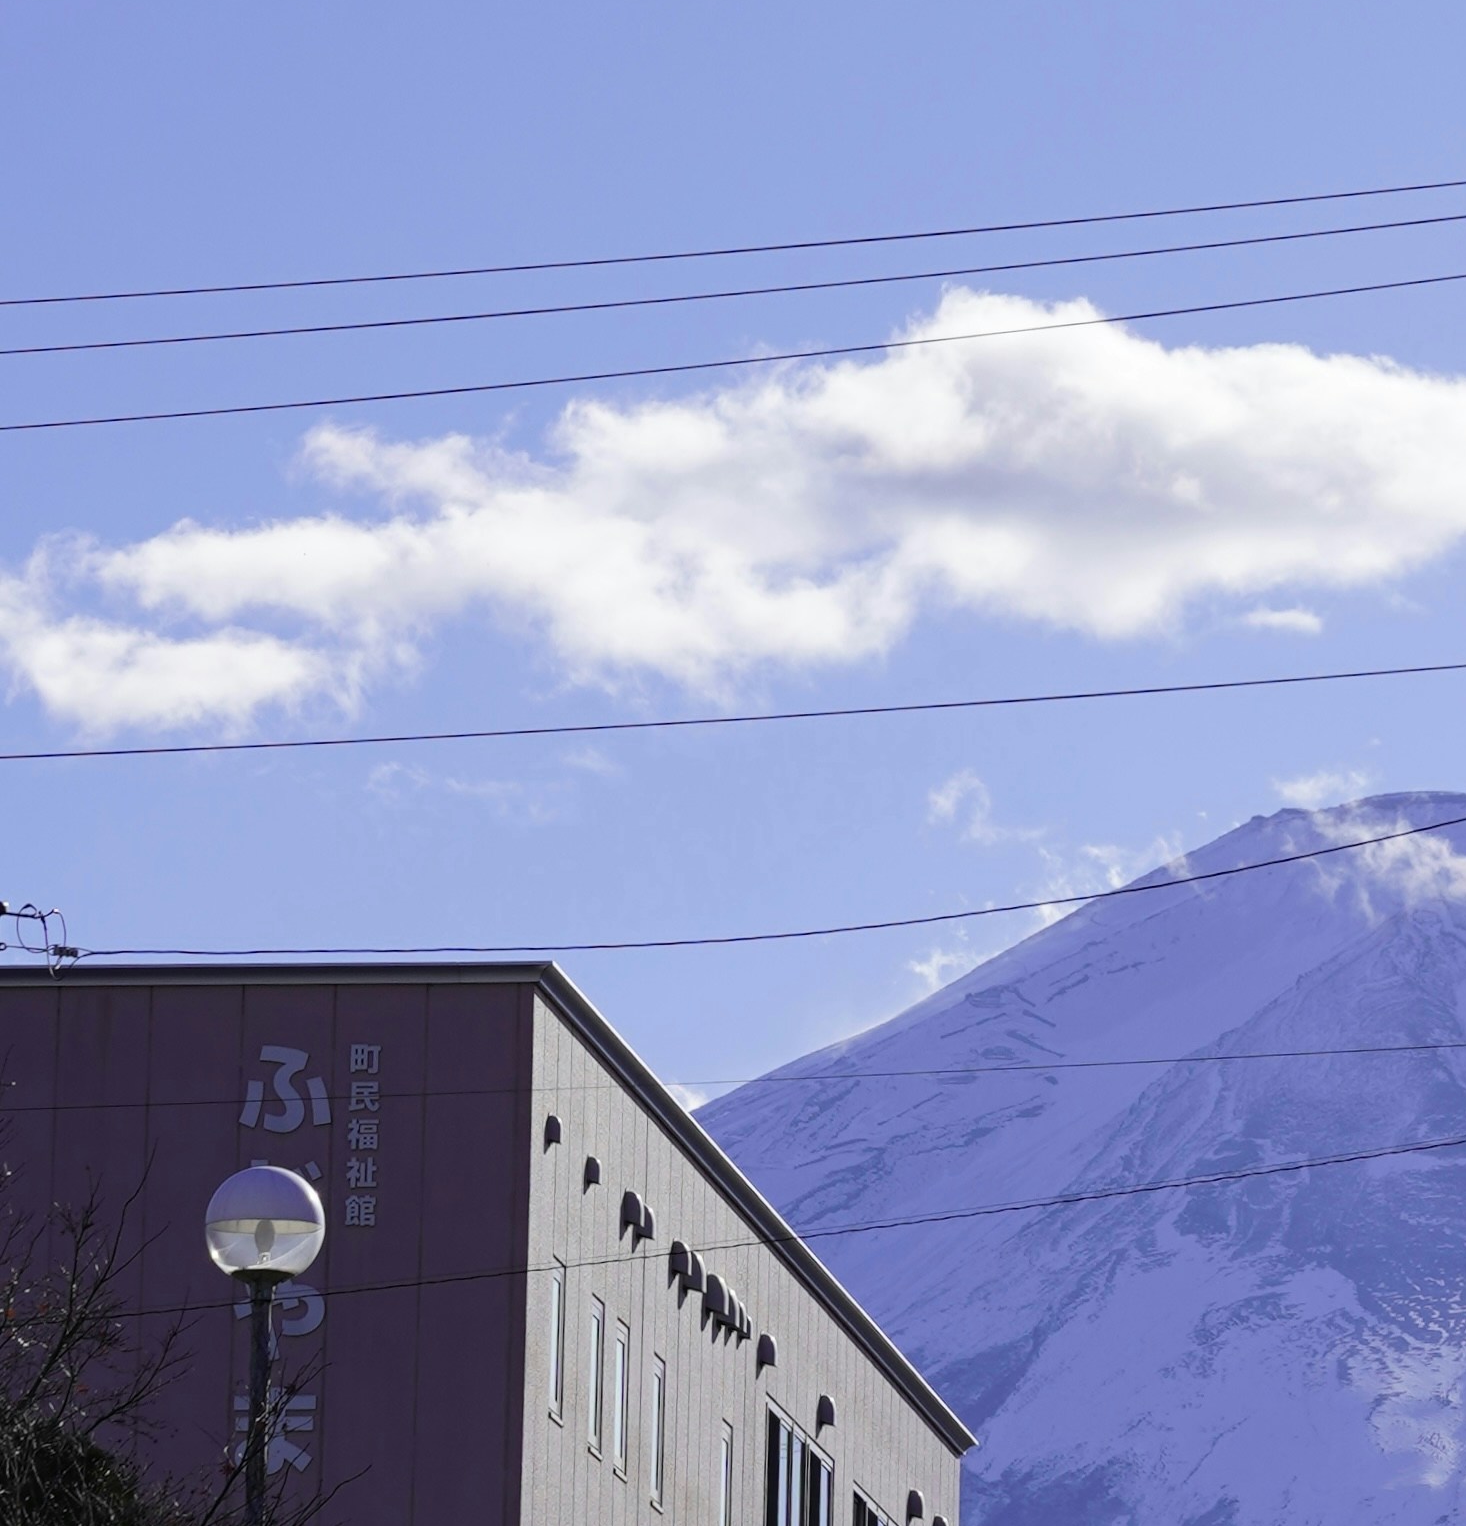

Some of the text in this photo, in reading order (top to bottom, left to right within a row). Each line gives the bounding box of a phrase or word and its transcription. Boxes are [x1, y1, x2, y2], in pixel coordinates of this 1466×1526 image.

[233, 1045, 332, 1474] ふやま
[344, 1043, 382, 1228] 町民福祉館
